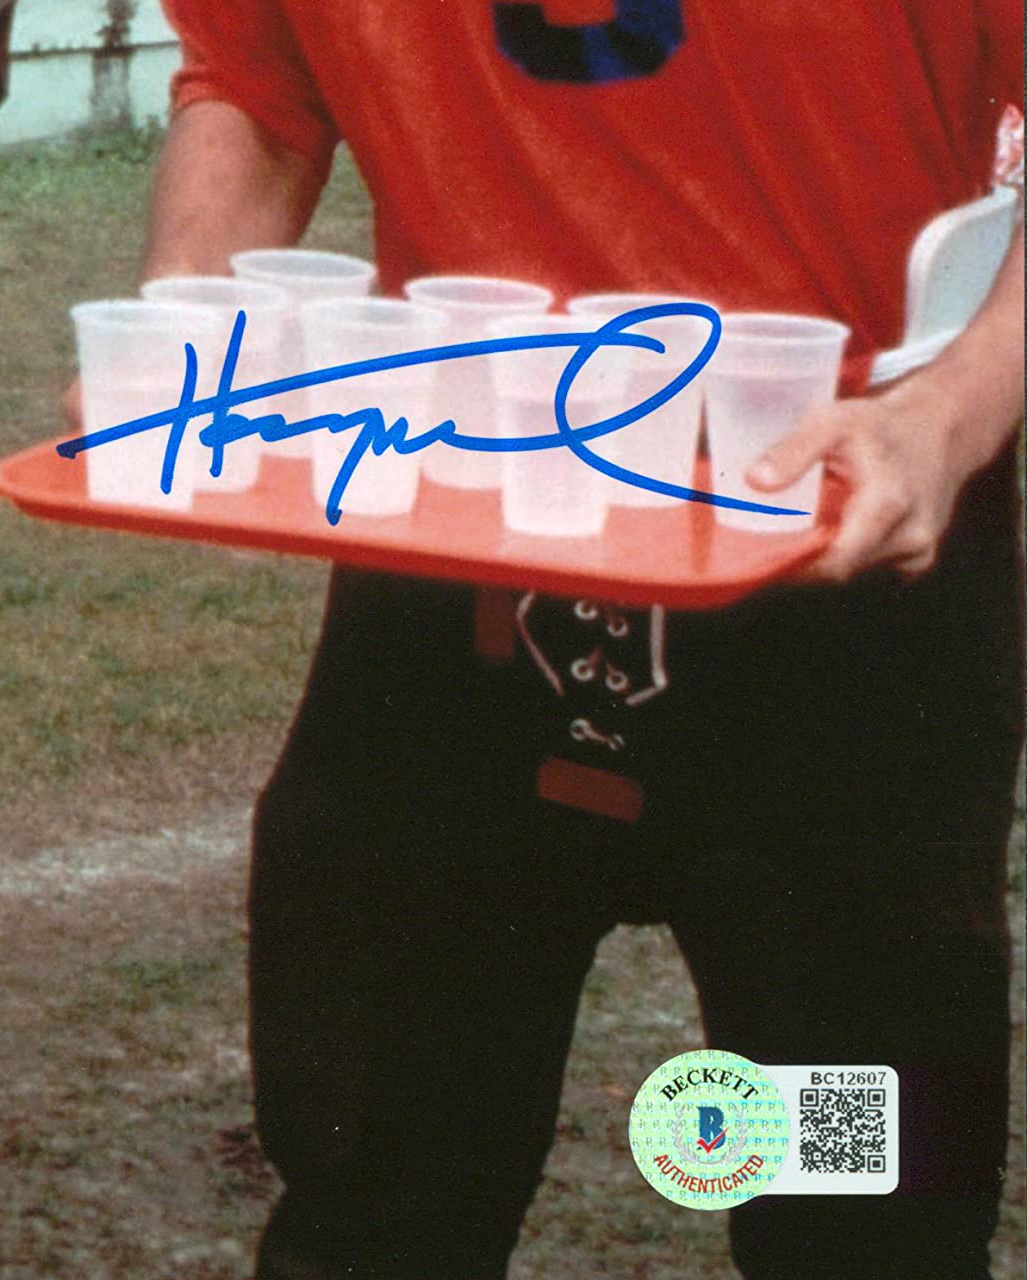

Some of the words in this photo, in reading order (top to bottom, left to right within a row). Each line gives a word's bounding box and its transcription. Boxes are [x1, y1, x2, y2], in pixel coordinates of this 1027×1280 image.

[660, 1067, 759, 1102] BECKETT
[810, 1071, 887, 1086] BC12607
[653, 1153, 765, 1194] AUTHENTICATED
